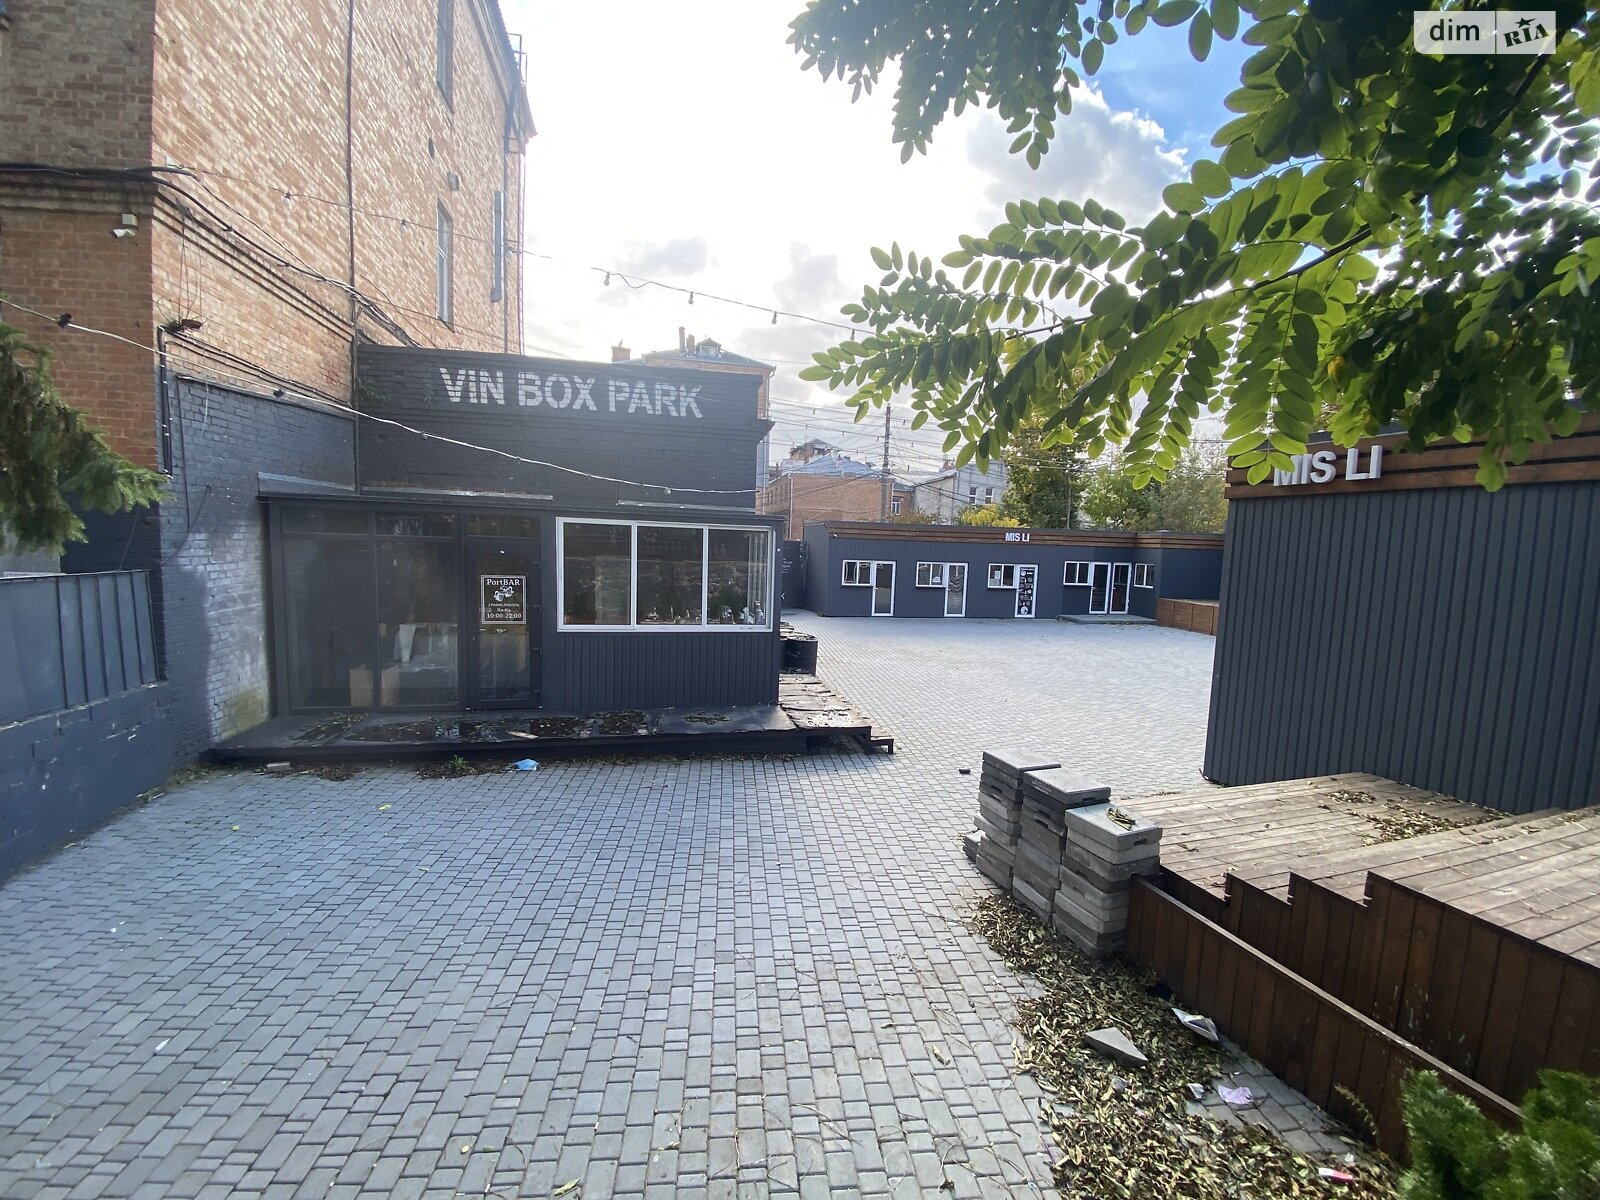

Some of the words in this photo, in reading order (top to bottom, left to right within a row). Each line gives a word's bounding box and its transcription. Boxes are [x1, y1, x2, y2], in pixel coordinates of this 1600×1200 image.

[439, 367, 505, 405] VIN
[517, 371, 598, 411] BOX
[608, 379, 703, 419] PARK
[1273, 450, 1337, 487] MIS
[1345, 444, 1383, 480] LI
[1005, 532, 1020, 542] MIS
[1021, 532, 1030, 542] LI
[486, 578, 520, 586] PortBAR
